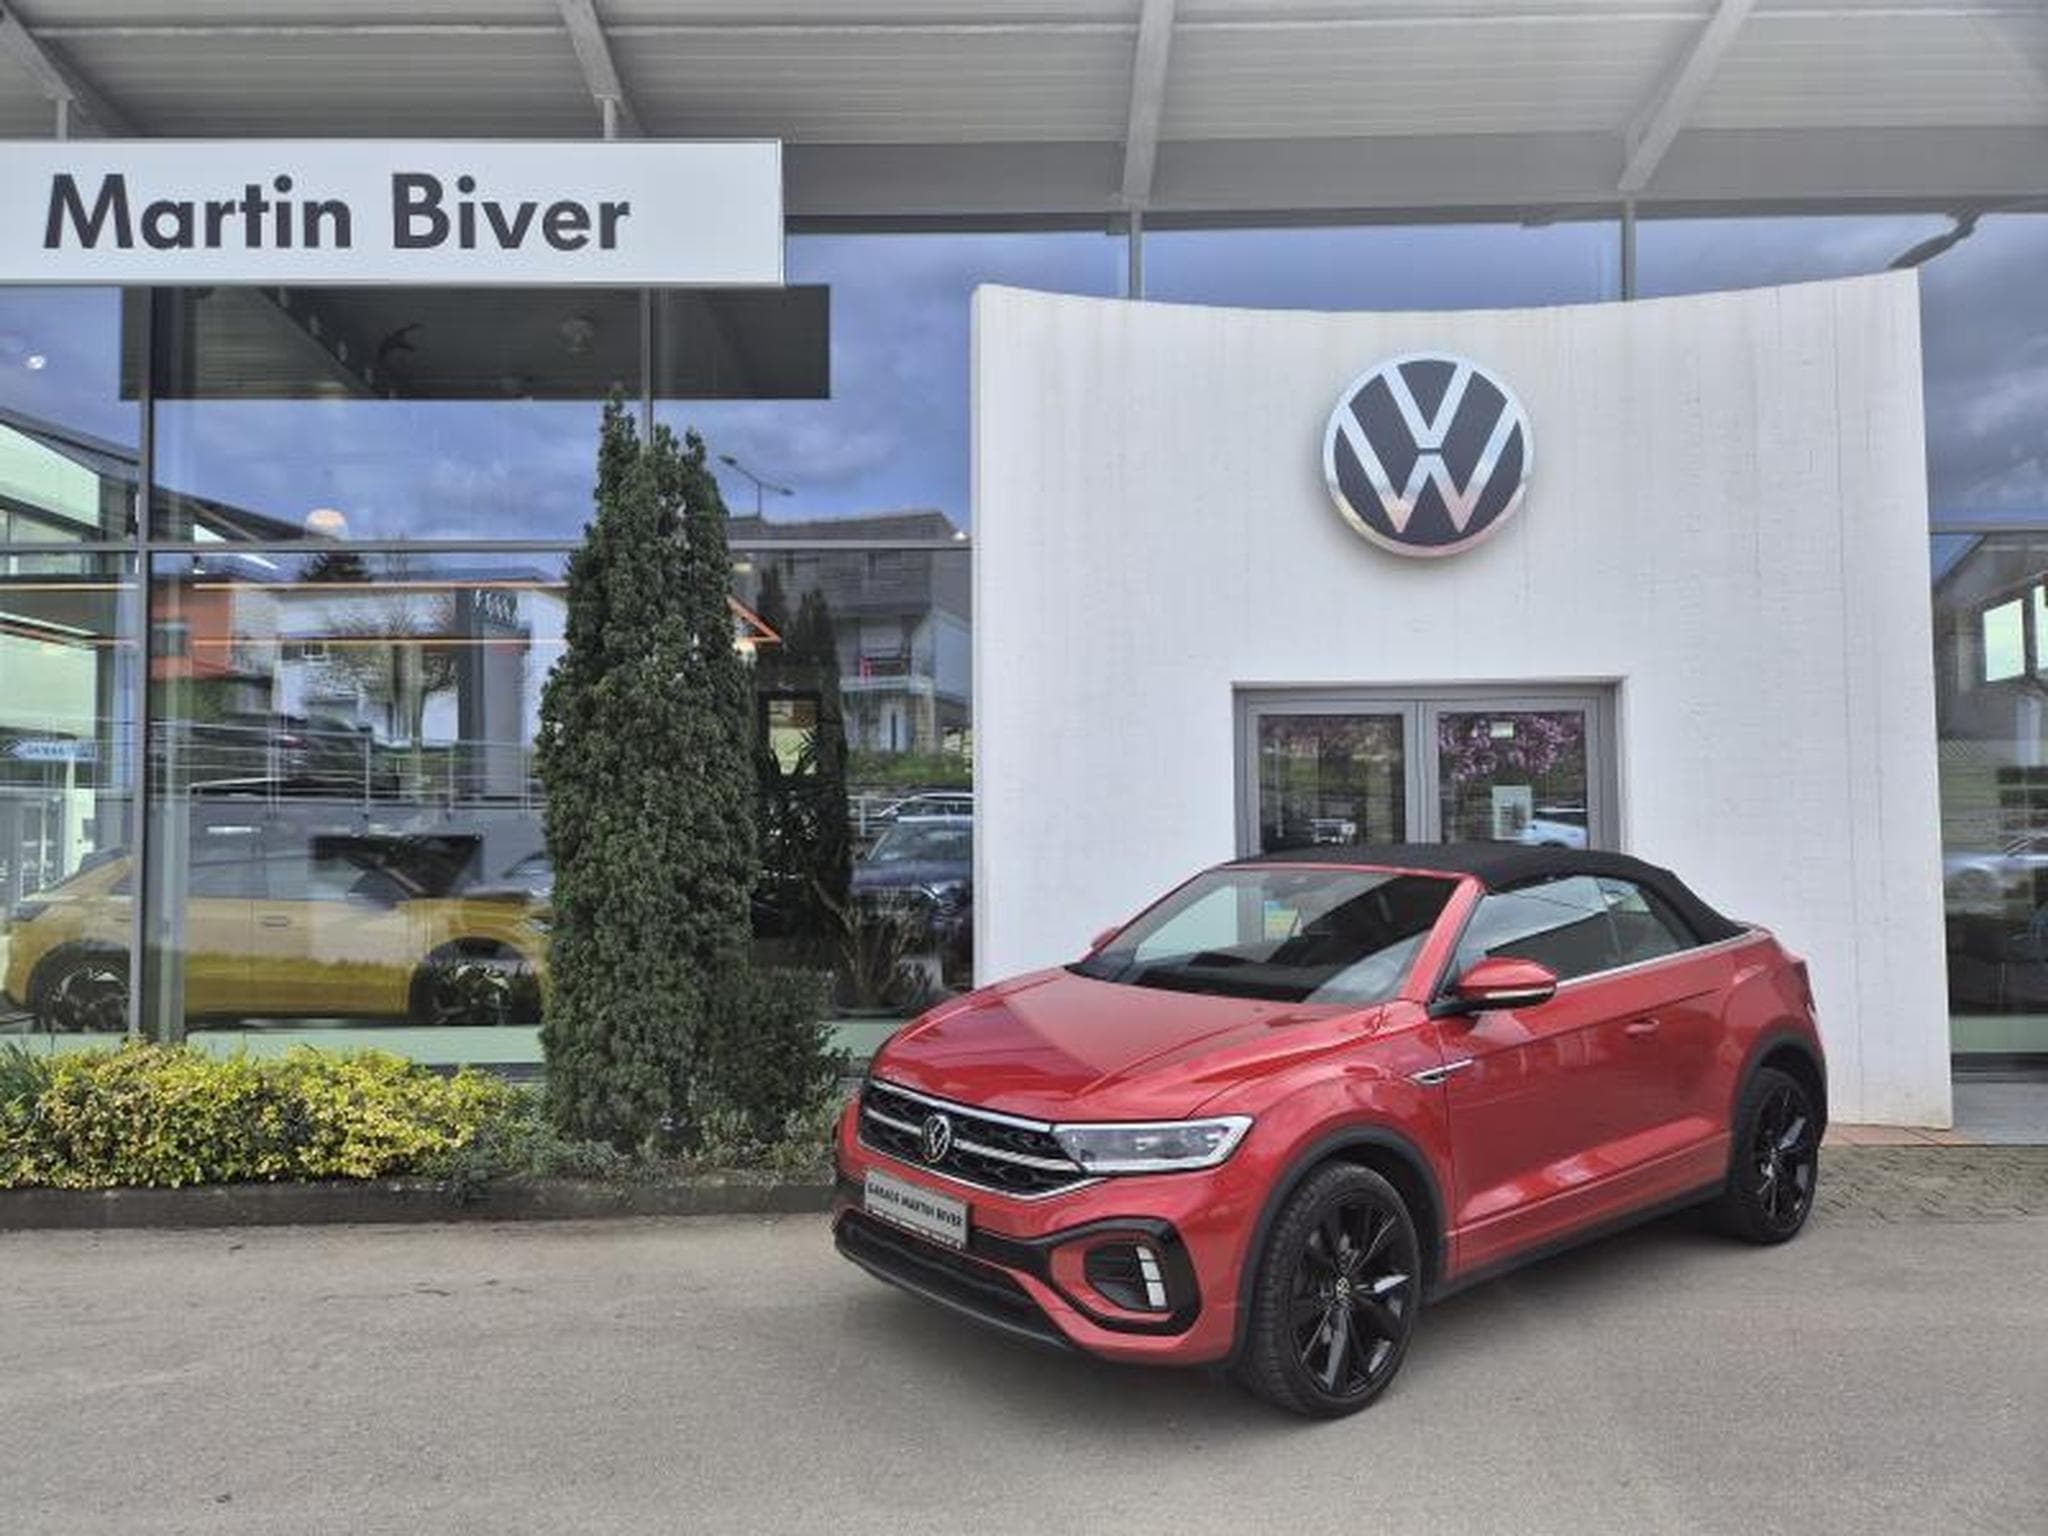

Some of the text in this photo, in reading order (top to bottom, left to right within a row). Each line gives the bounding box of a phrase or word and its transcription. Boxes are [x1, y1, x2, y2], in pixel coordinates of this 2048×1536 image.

[43, 172, 631, 250] Martin Biver
[1332, 358, 1525, 540] VW
